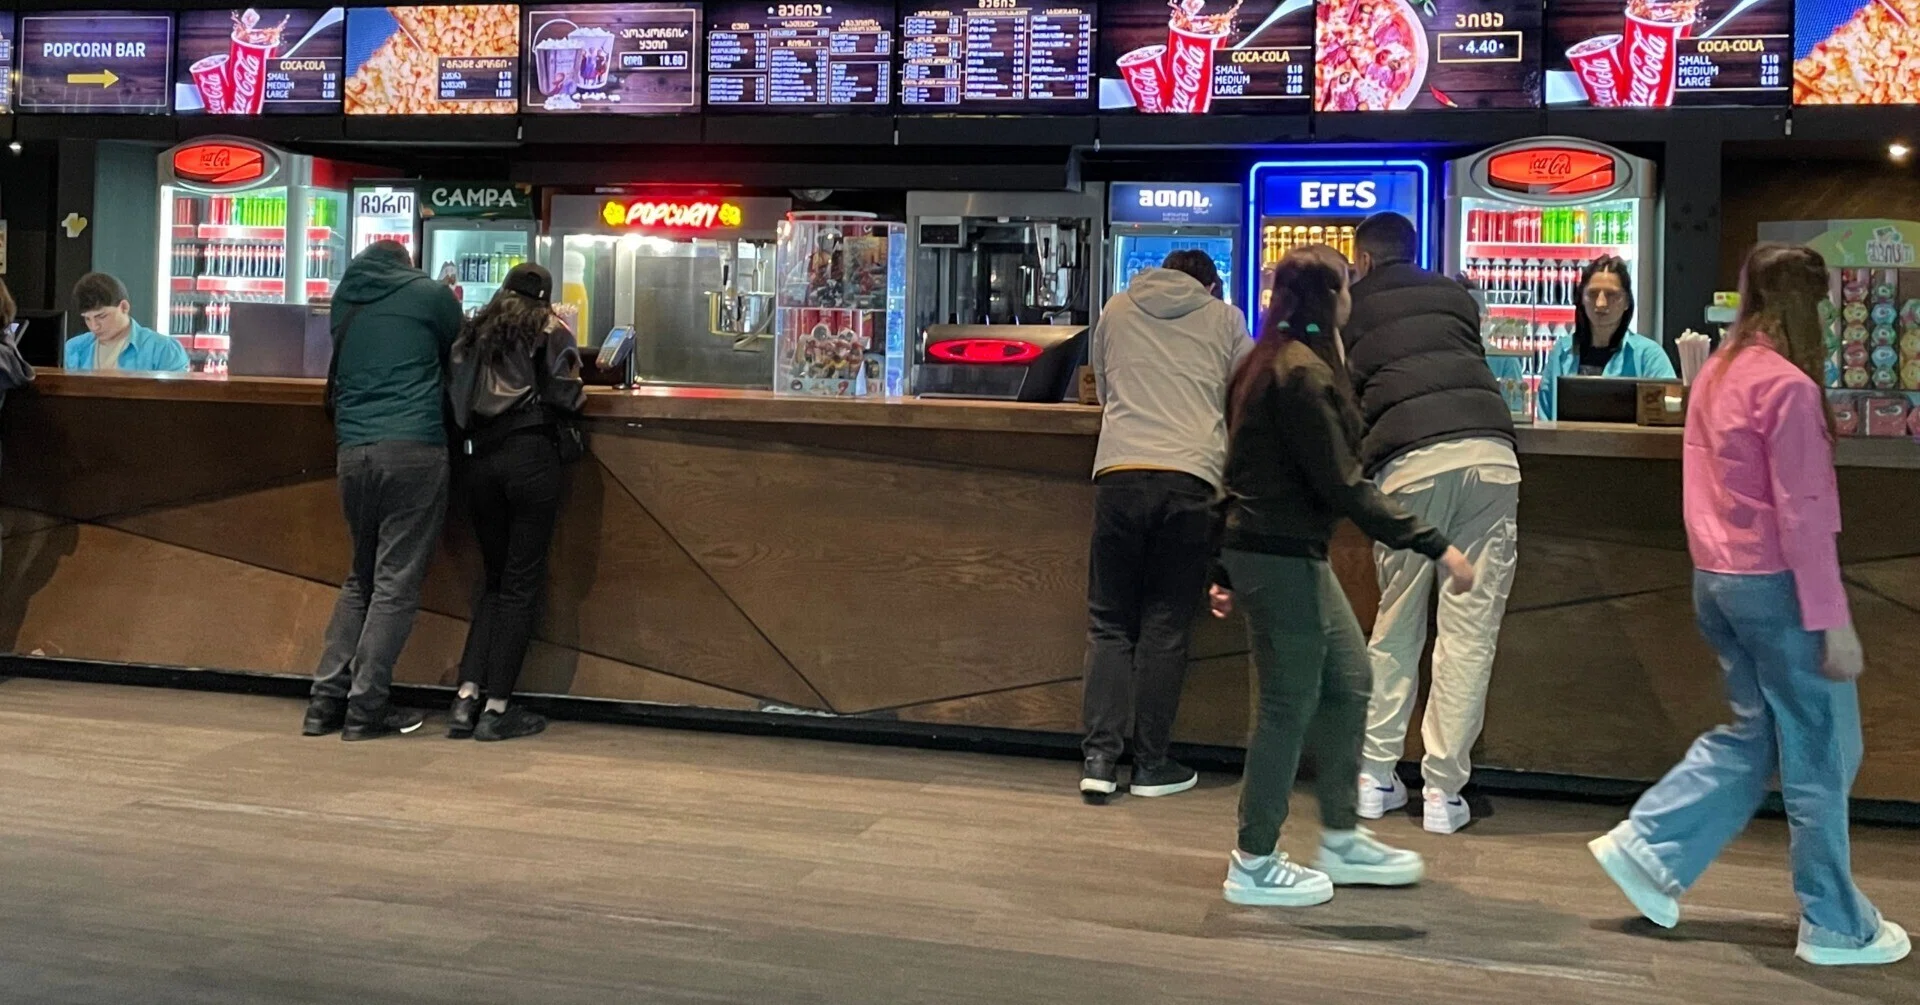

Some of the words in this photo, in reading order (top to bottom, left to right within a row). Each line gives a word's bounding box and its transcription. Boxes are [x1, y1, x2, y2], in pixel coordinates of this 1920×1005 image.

[778, 4, 822, 16] მენიუ
[43, 42, 112, 57] POPCORN
[115, 42, 146, 57] BAR
[1465, 39, 1498, 53] 4.40
[1697, 40, 1765, 52] COCA-COLA
[1231, 50, 1291, 62] COCA-COLA
[1678, 55, 1712, 66] SMALL
[280, 61, 326, 70] COCA-COLA
[1215, 65, 1244, 75] SMALL
[1678, 66, 1719, 76] MEDIUM
[267, 73, 289, 81] SMALL
[1215, 75, 1251, 84] MEDIUM
[1678, 76, 1711, 86] LARGE
[266, 90, 289, 98] LARGE
[1214, 85, 1244, 95] LARGE
[432, 187, 517, 208] CAMPA
[1301, 181, 1377, 209] EFES
[625, 202, 719, 227] POPCORN
